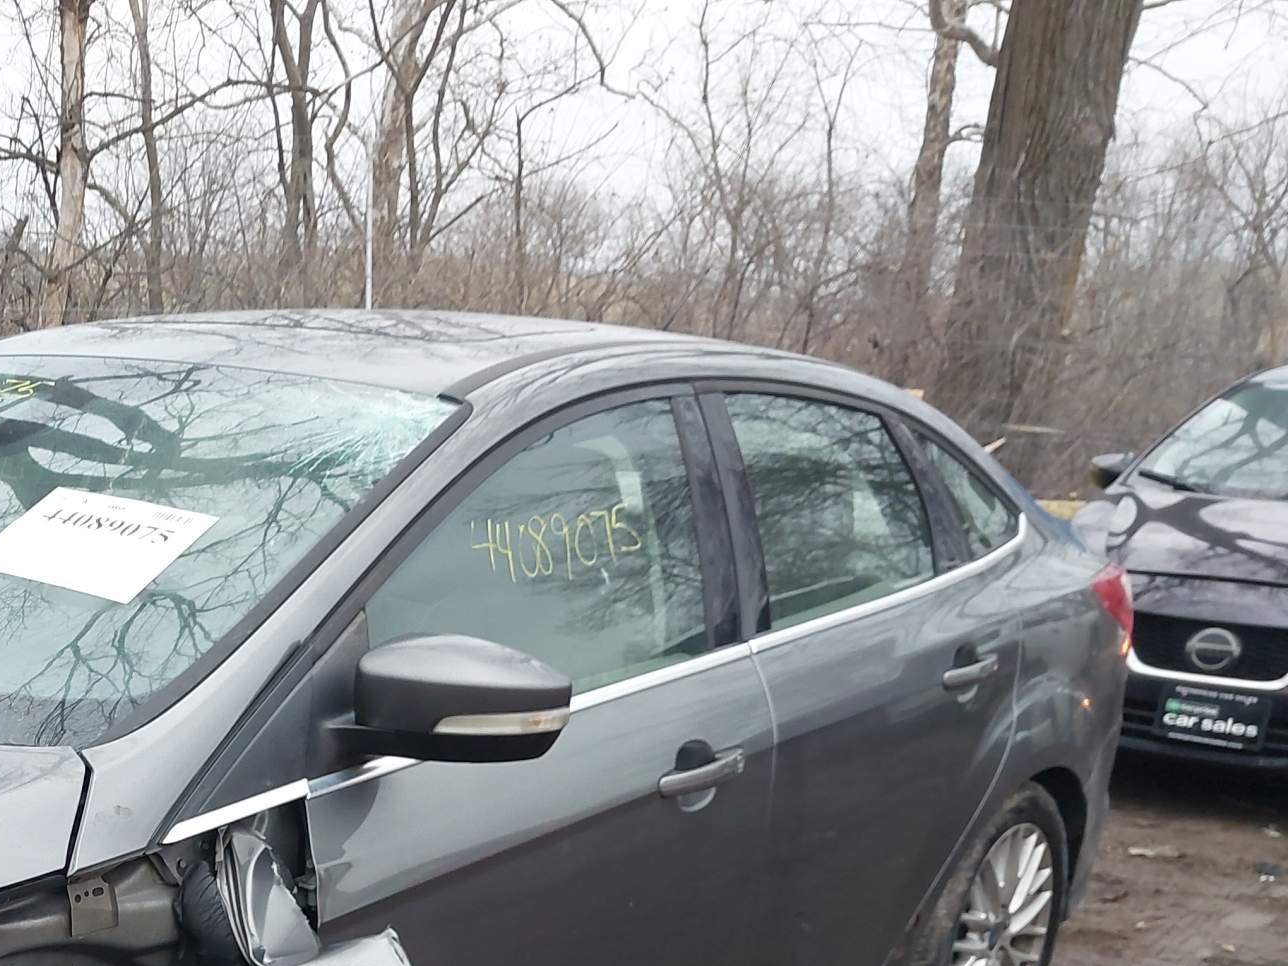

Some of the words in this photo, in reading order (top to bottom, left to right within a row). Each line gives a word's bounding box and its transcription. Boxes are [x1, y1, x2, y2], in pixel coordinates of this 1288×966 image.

[43, 508, 175, 544] 44089075
[471, 503, 642, 583] 44089075
[1162, 712, 1200, 729] car
[1200, 716, 1259, 738] sales
